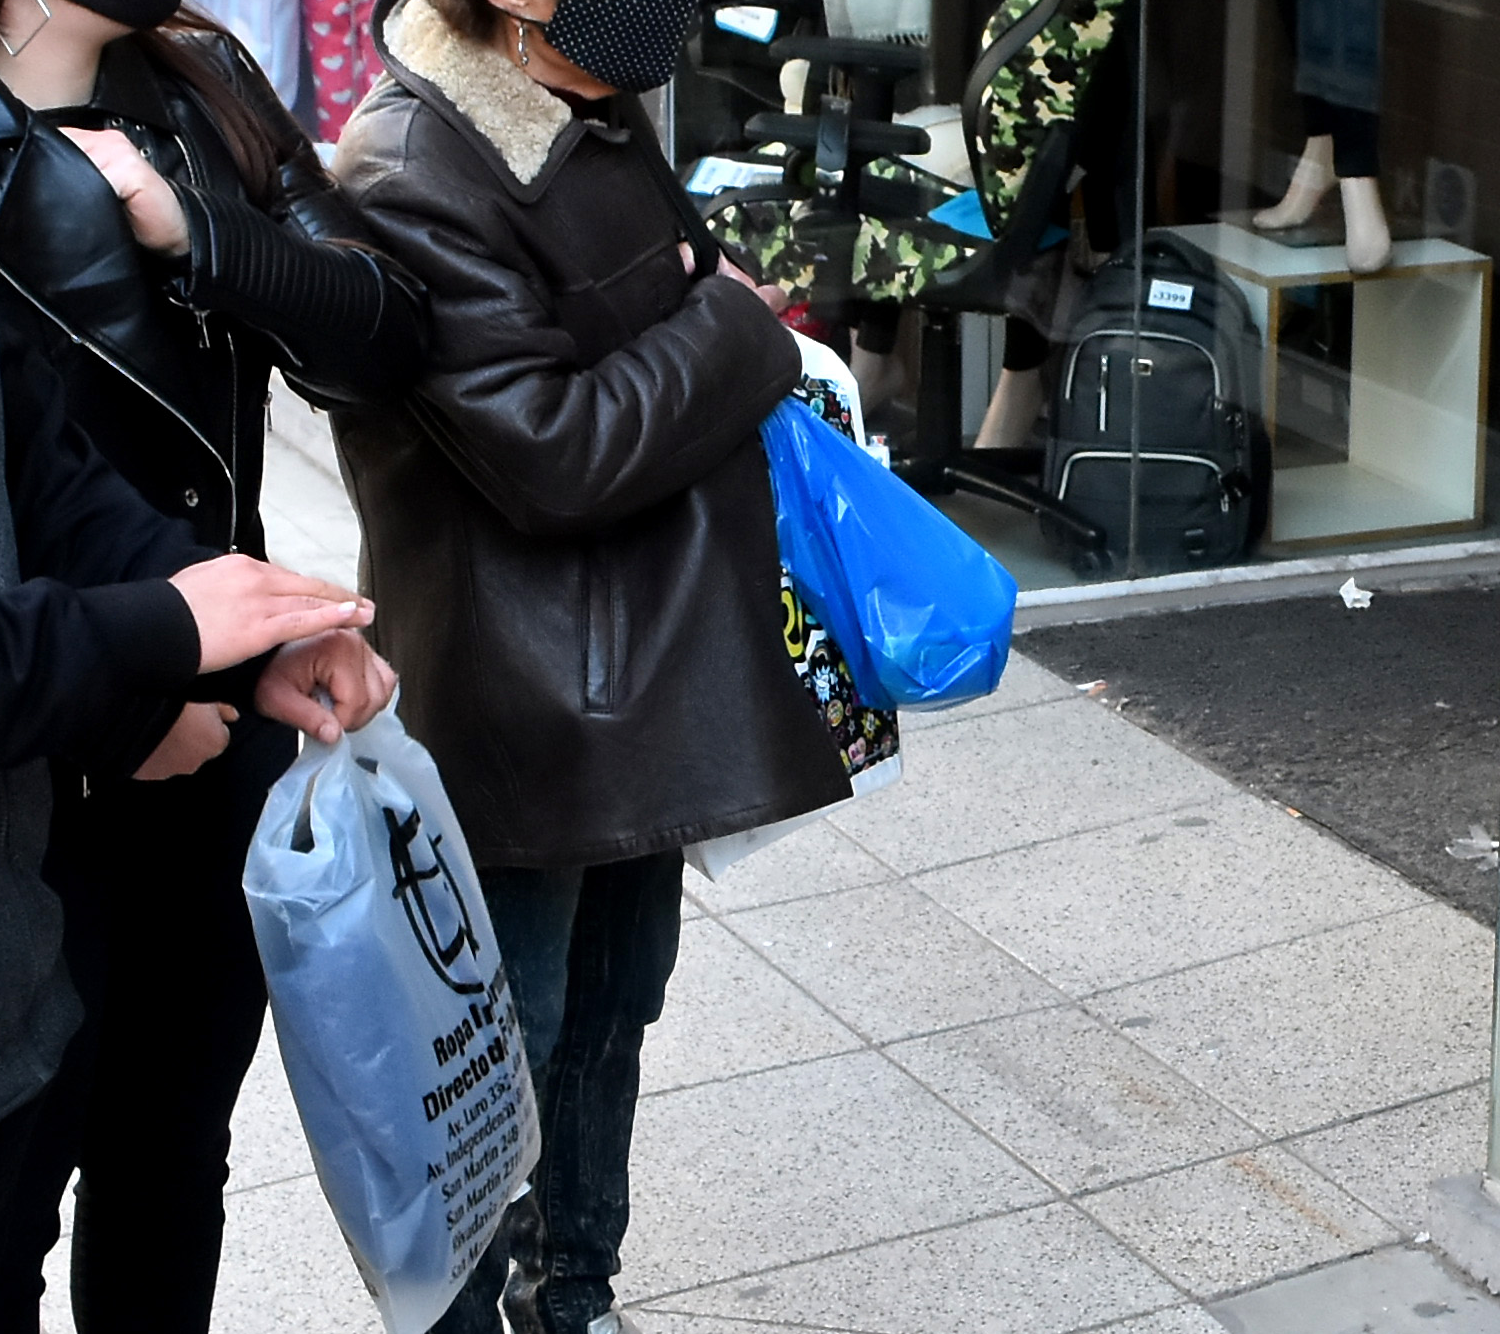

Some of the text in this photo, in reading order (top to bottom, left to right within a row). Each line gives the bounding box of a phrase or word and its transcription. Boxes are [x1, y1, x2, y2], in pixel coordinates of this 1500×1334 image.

[433, 1017, 475, 1067] Ropa
[422, 1053, 491, 1122] Directo
[463, 1100, 489, 1127] Luro
[441, 1178, 462, 1204] San
